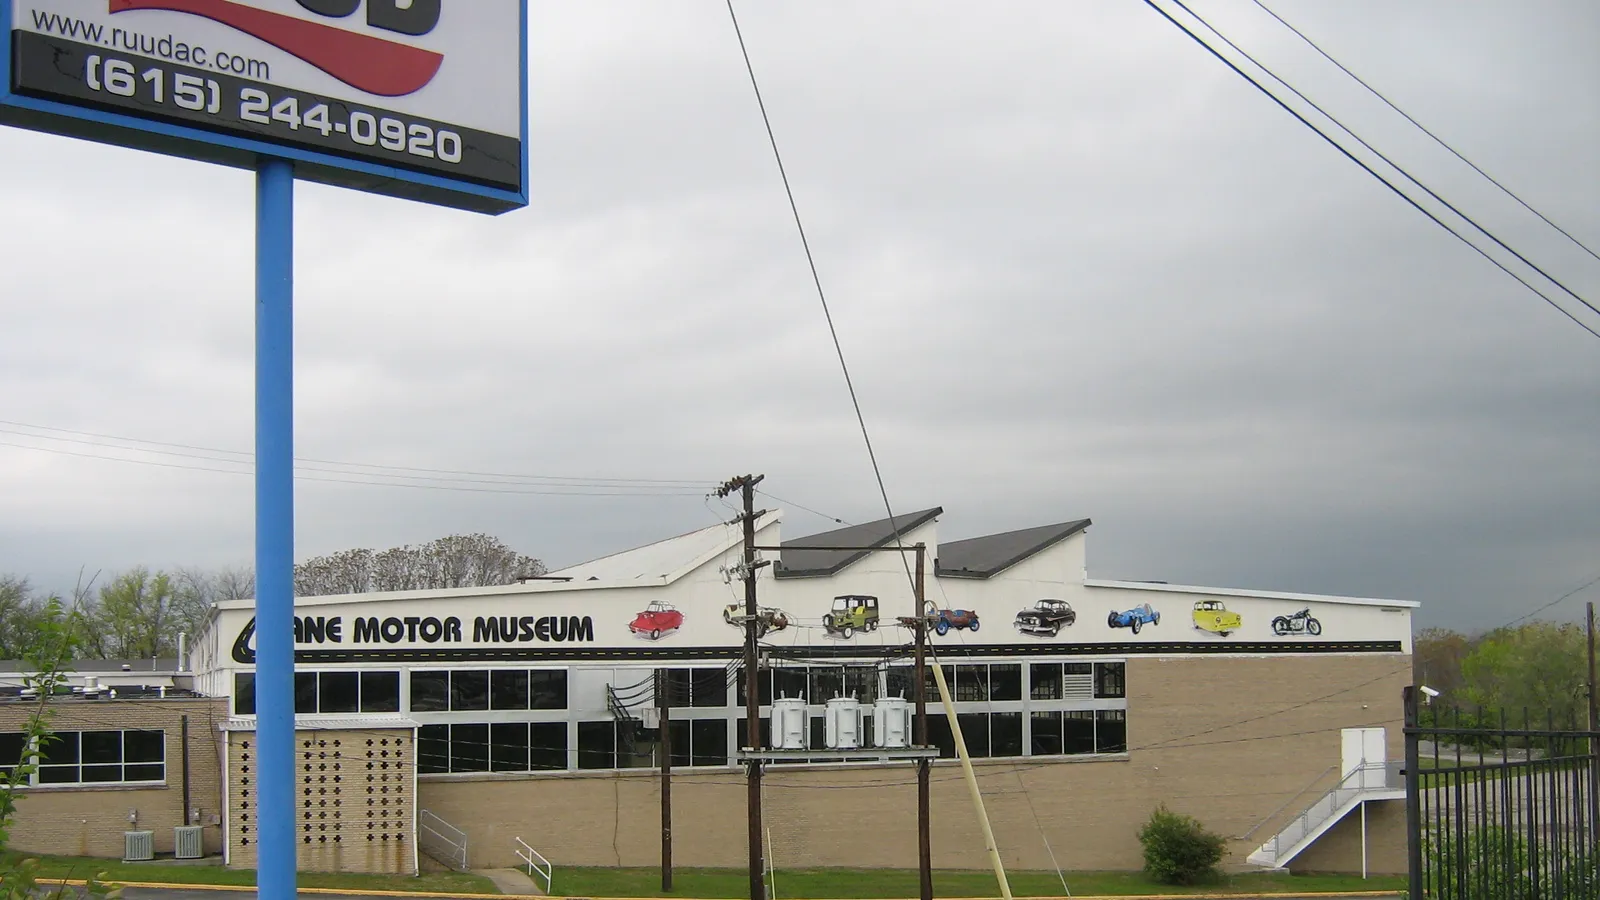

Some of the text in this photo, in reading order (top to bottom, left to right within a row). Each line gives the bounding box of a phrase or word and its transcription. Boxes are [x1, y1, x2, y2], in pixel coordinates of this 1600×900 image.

[31, 8, 270, 81] www.ruudac.com
[86, 54, 463, 164] (615) 244-0920
[353, 616, 462, 643] MOTOR
[473, 616, 594, 643] MUSEUM
